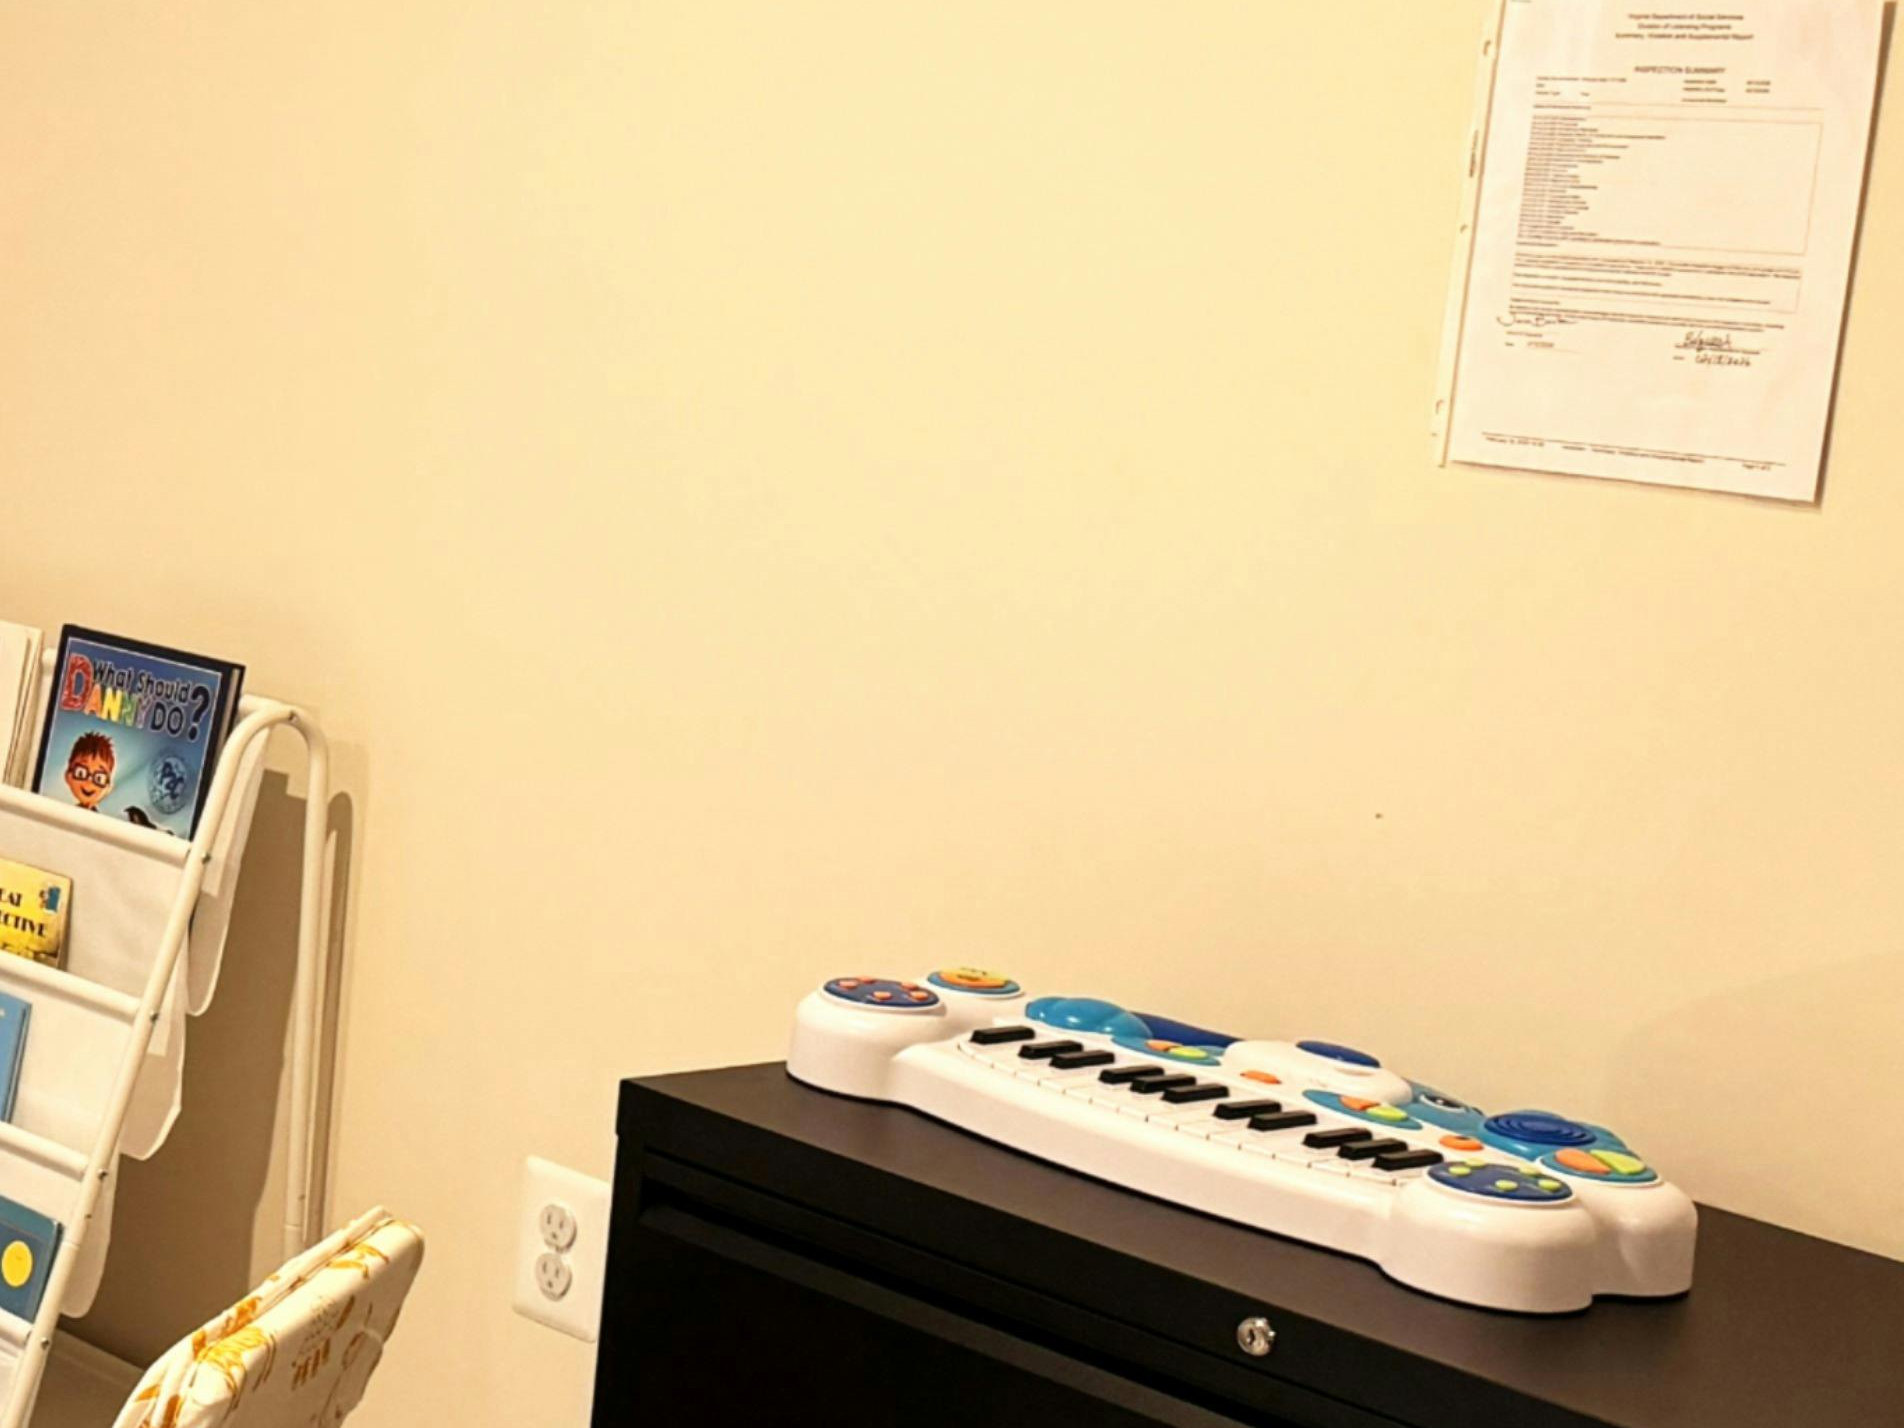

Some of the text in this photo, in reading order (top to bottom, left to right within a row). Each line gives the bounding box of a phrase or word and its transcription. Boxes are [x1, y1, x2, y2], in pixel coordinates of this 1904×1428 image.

[61, 652, 153, 729] DANNY
[92, 658, 193, 705] What Should
